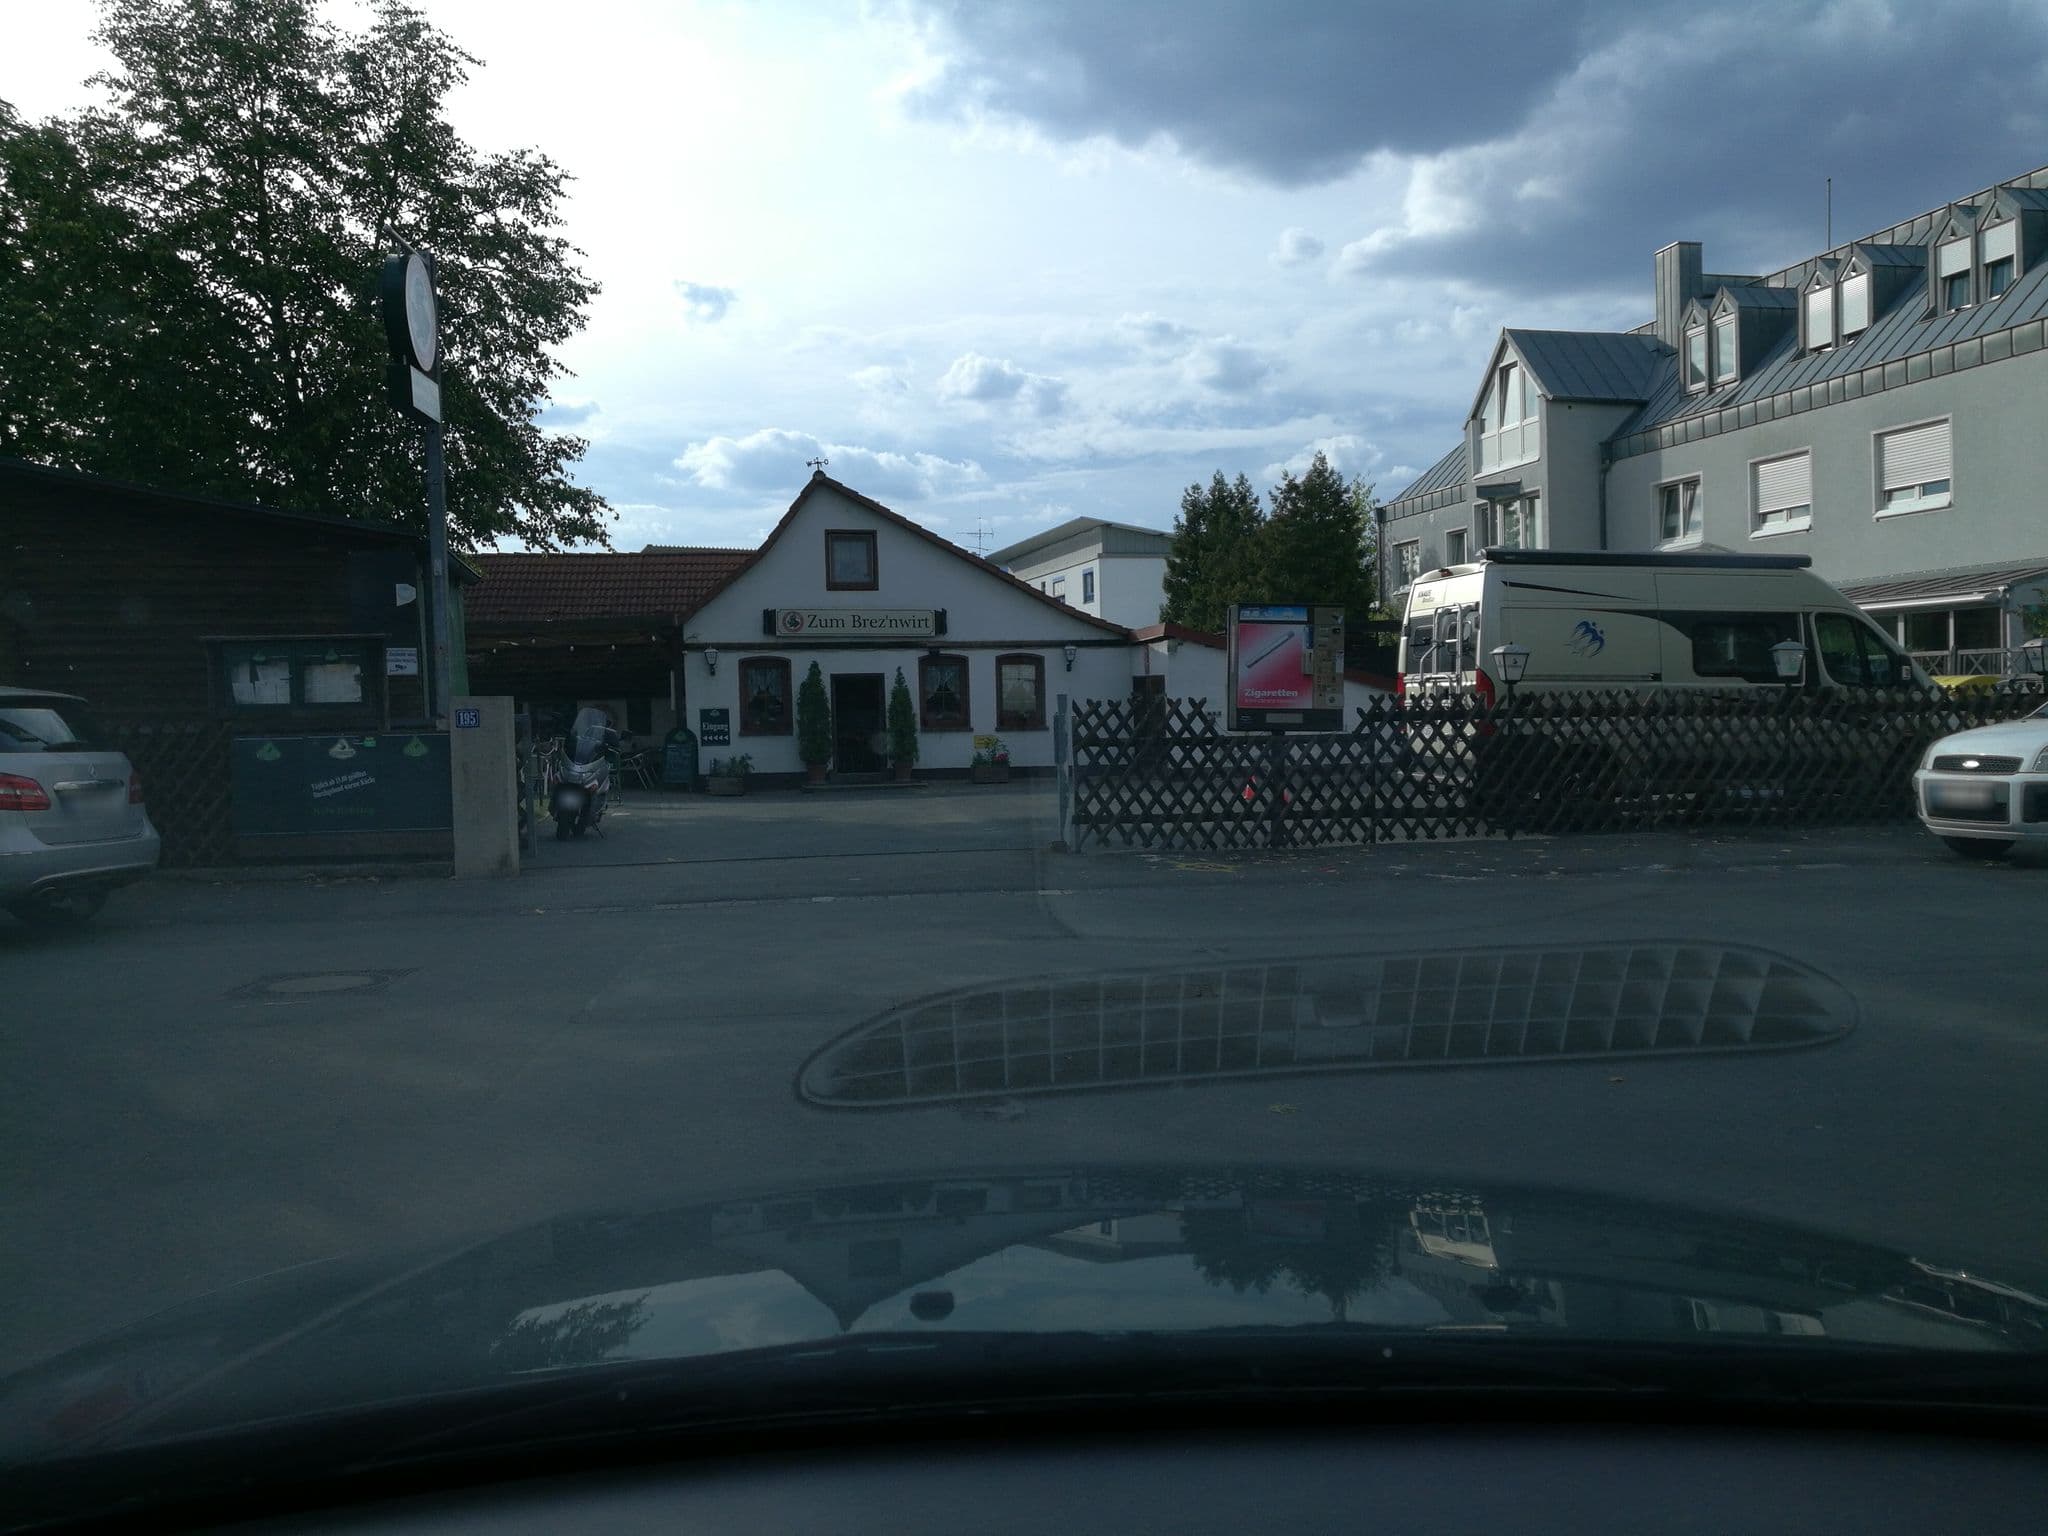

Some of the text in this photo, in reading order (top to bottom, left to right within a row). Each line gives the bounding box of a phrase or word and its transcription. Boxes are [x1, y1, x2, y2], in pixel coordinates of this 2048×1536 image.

[807, 613, 930, 629] Zum Brez'nwirt
[1244, 688, 1299, 699] Zigaretten
[459, 712, 477, 726] 195
